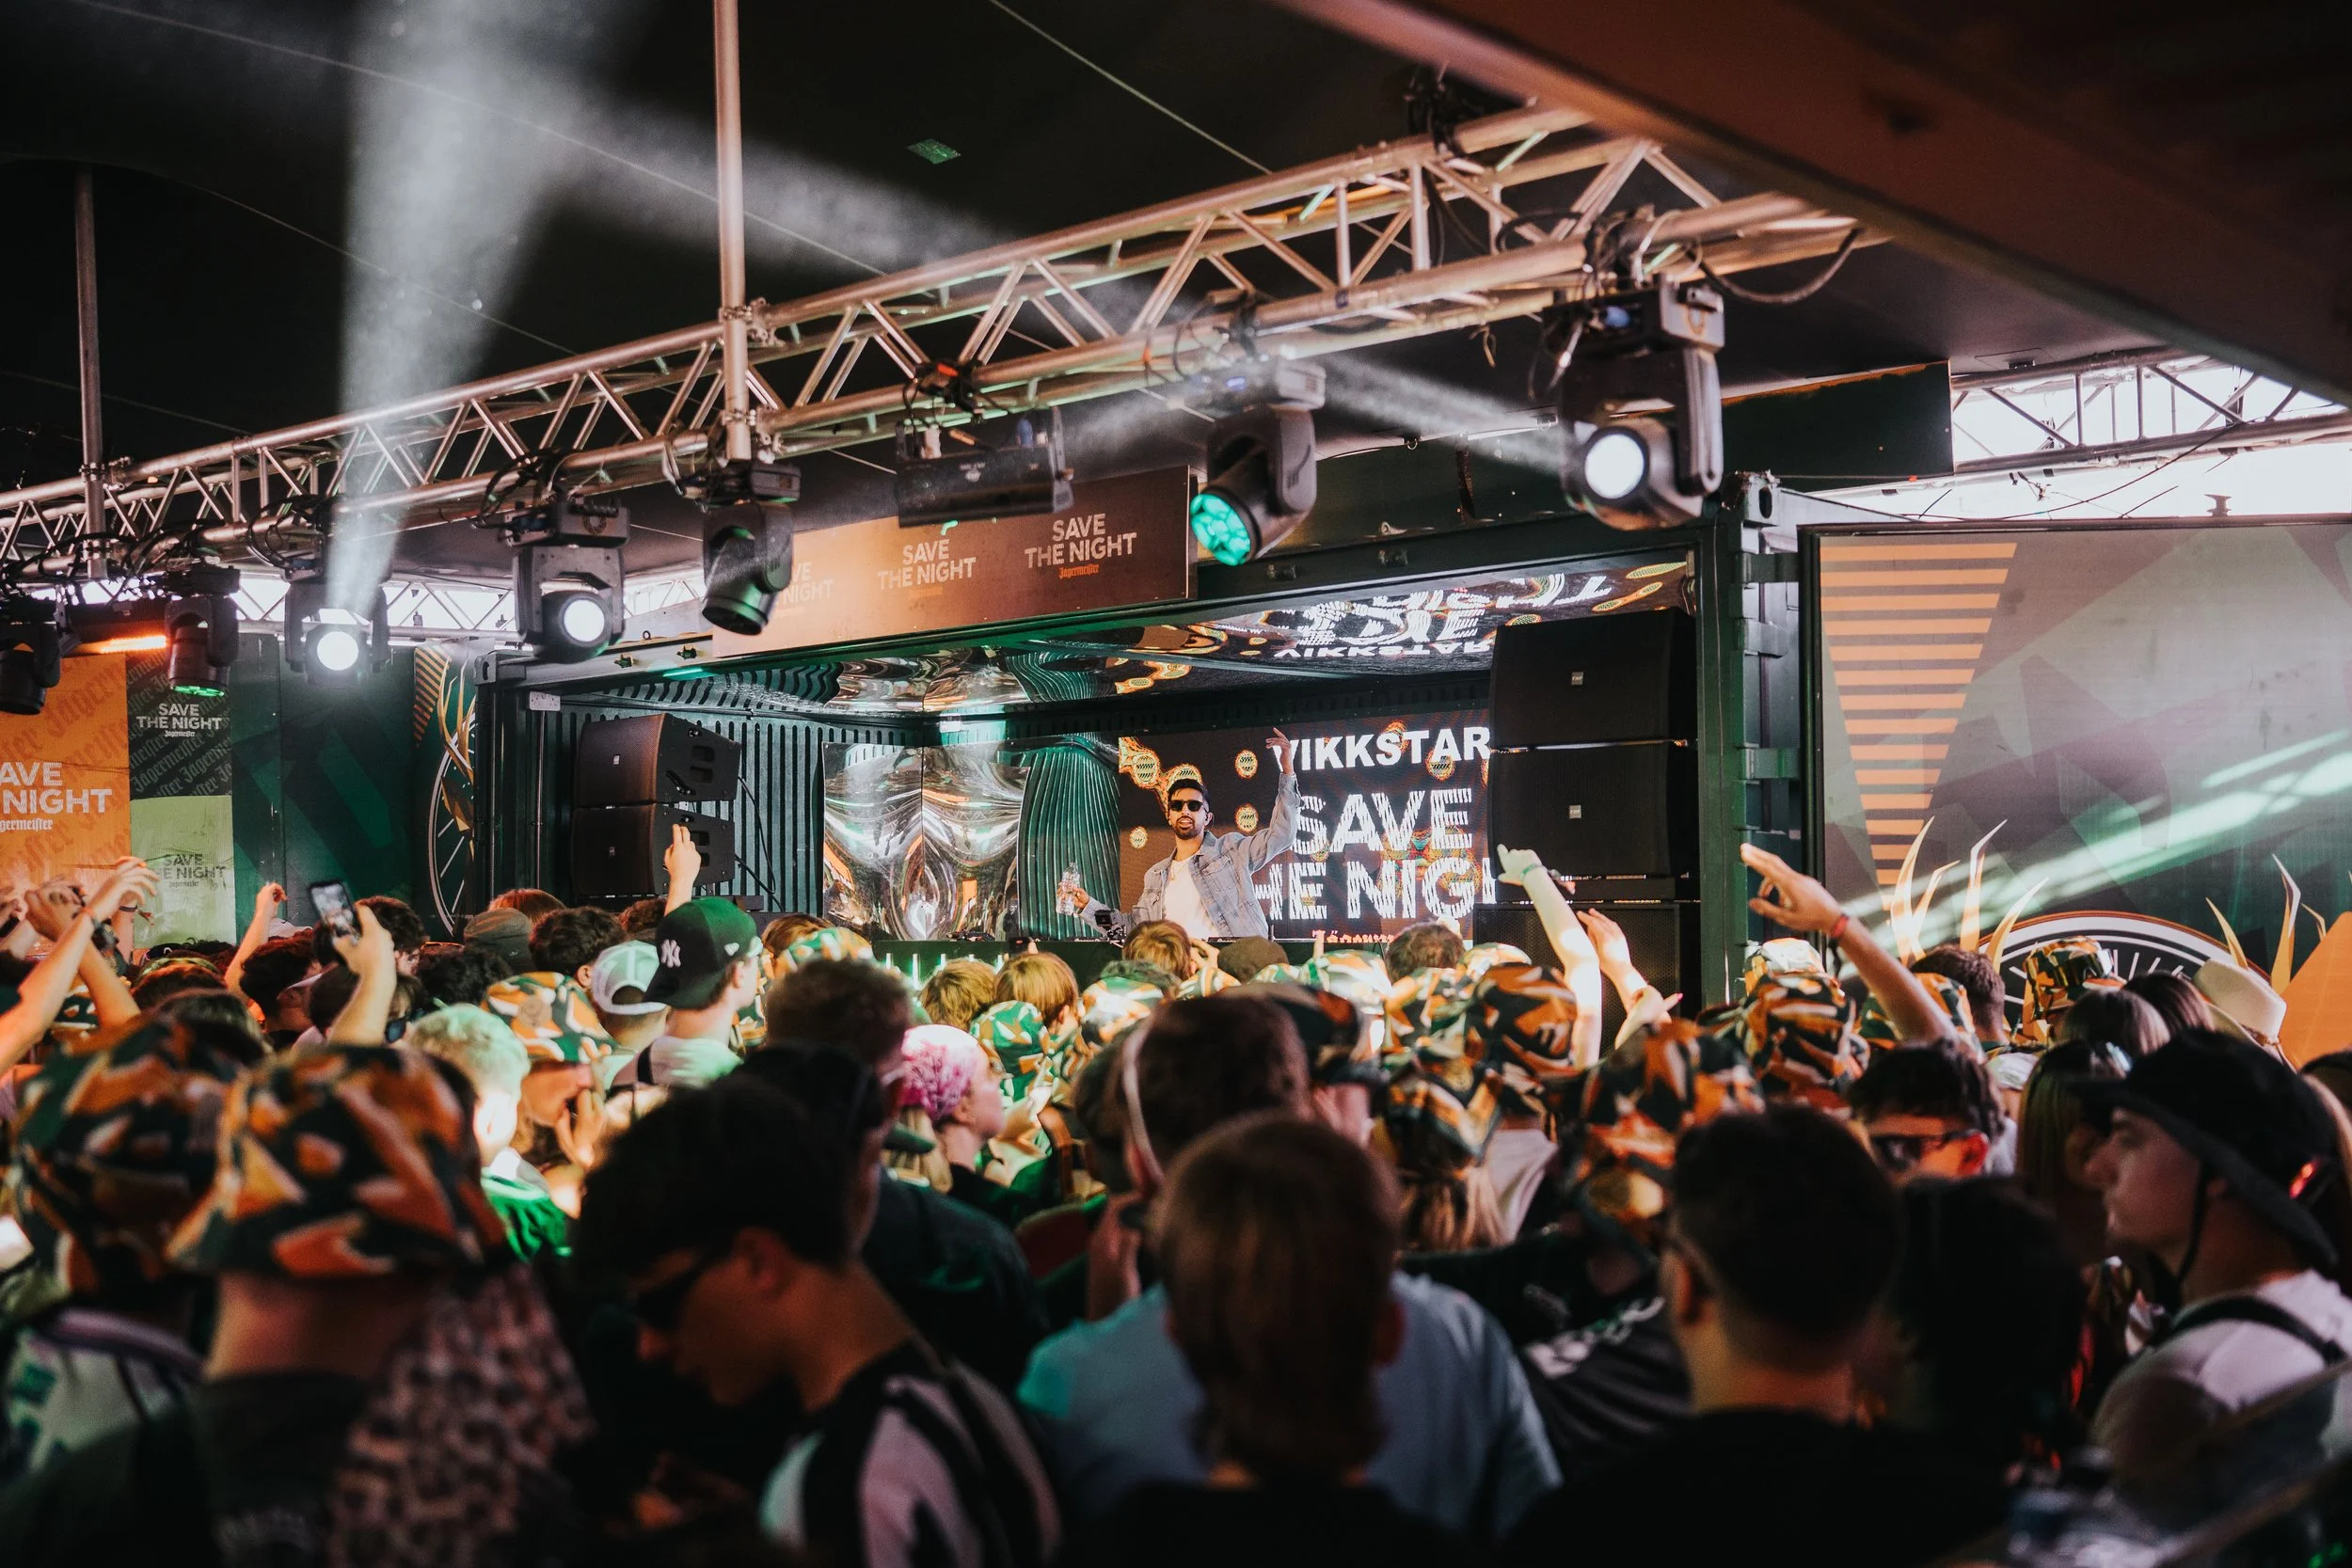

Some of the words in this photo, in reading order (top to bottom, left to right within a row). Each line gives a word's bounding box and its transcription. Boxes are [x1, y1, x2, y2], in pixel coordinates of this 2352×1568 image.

[1053, 514, 1105, 542] SAVE
[903, 539, 949, 564] SAVE
[1025, 544, 1064, 569] THE
[1070, 532, 1137, 562] NIGHT
[791, 562, 812, 582] VE
[878, 566, 913, 590] THE
[917, 557, 977, 585] NIGHT
[783, 578, 834, 605] NIGHT
[158, 703, 199, 717] SAVE
[136, 716, 168, 729] THE
[172, 717, 223, 730] NIGHT
[0, 762, 63, 786] AVE
[3, 788, 113, 814] NIGHT
[0, 817, 54, 832] germeister
[1291, 787, 1472, 855] SAVE
[177, 866, 227, 879] NIGHT
[1254, 861, 1327, 920] HE
[1347, 856, 1496, 920] NIG
